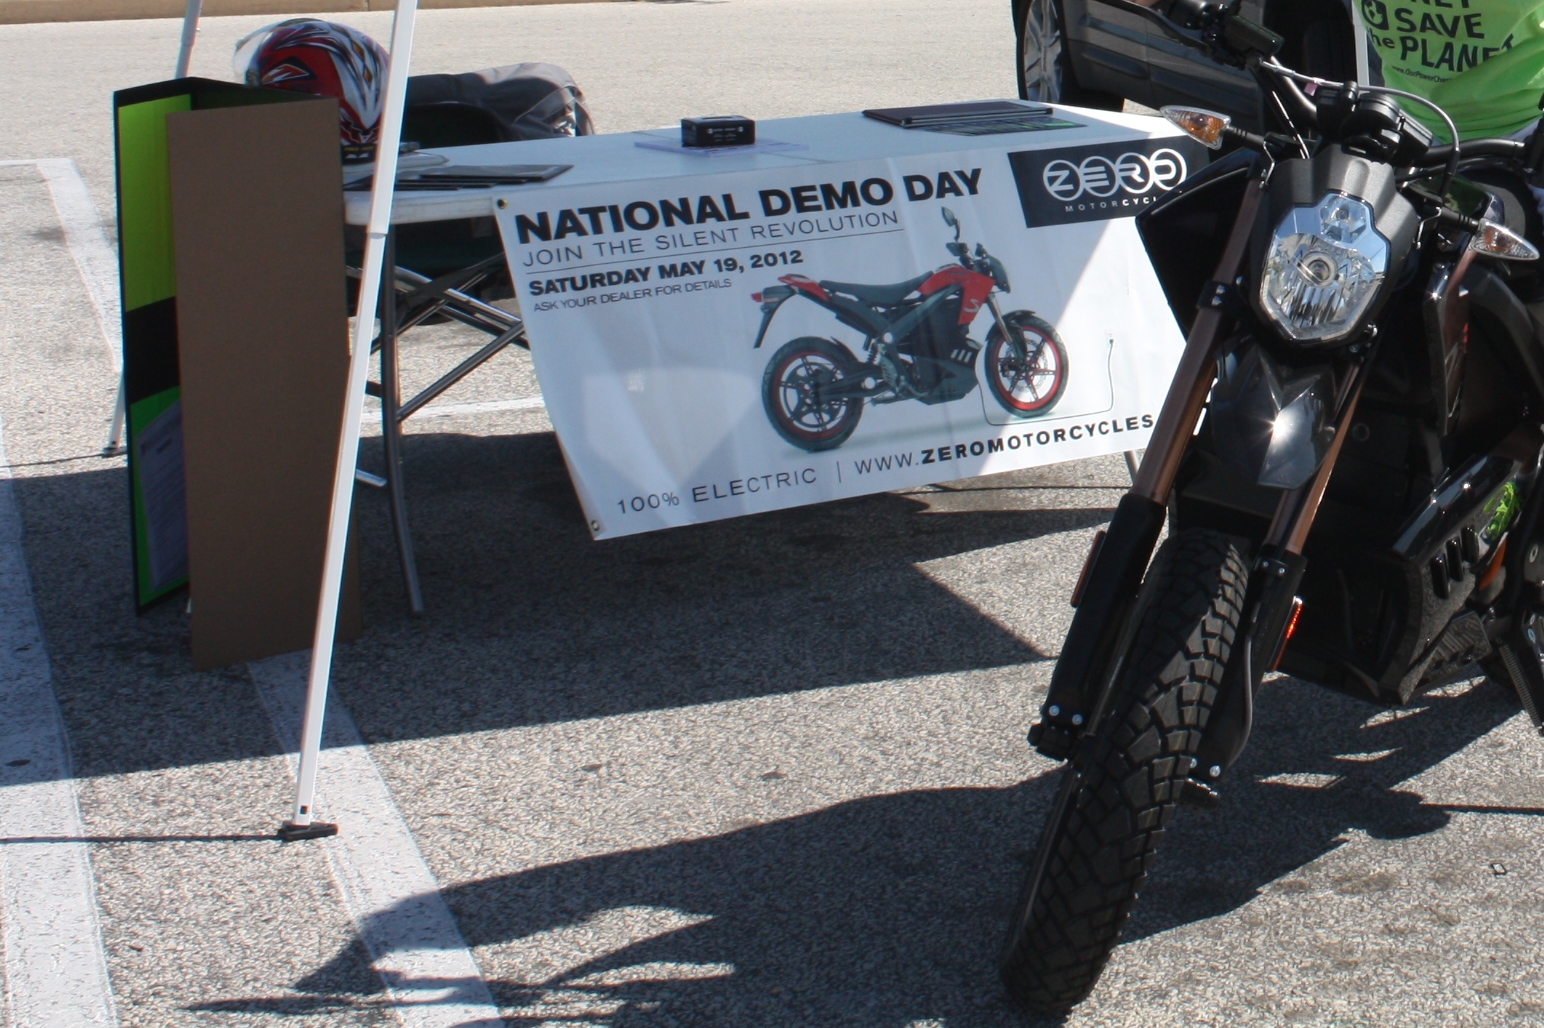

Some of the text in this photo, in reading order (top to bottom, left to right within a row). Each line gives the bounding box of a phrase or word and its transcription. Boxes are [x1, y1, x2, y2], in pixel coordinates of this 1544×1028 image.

[1395, 8, 1485, 39] SAVE
[1043, 148, 1187, 201] ZERO
[515, 168, 982, 244] NATIONAL DEMO DAY
[523, 211, 898, 267] JOIN THE SILENT REVOLUTION
[529, 250, 803, 296] SATURDAY MAY 19, 2012
[534, 278, 732, 312] ASK YOUR DEALER FOR DETAILS
[618, 492, 680, 514] 100%
[692, 468, 817, 503] ELECTRIC
